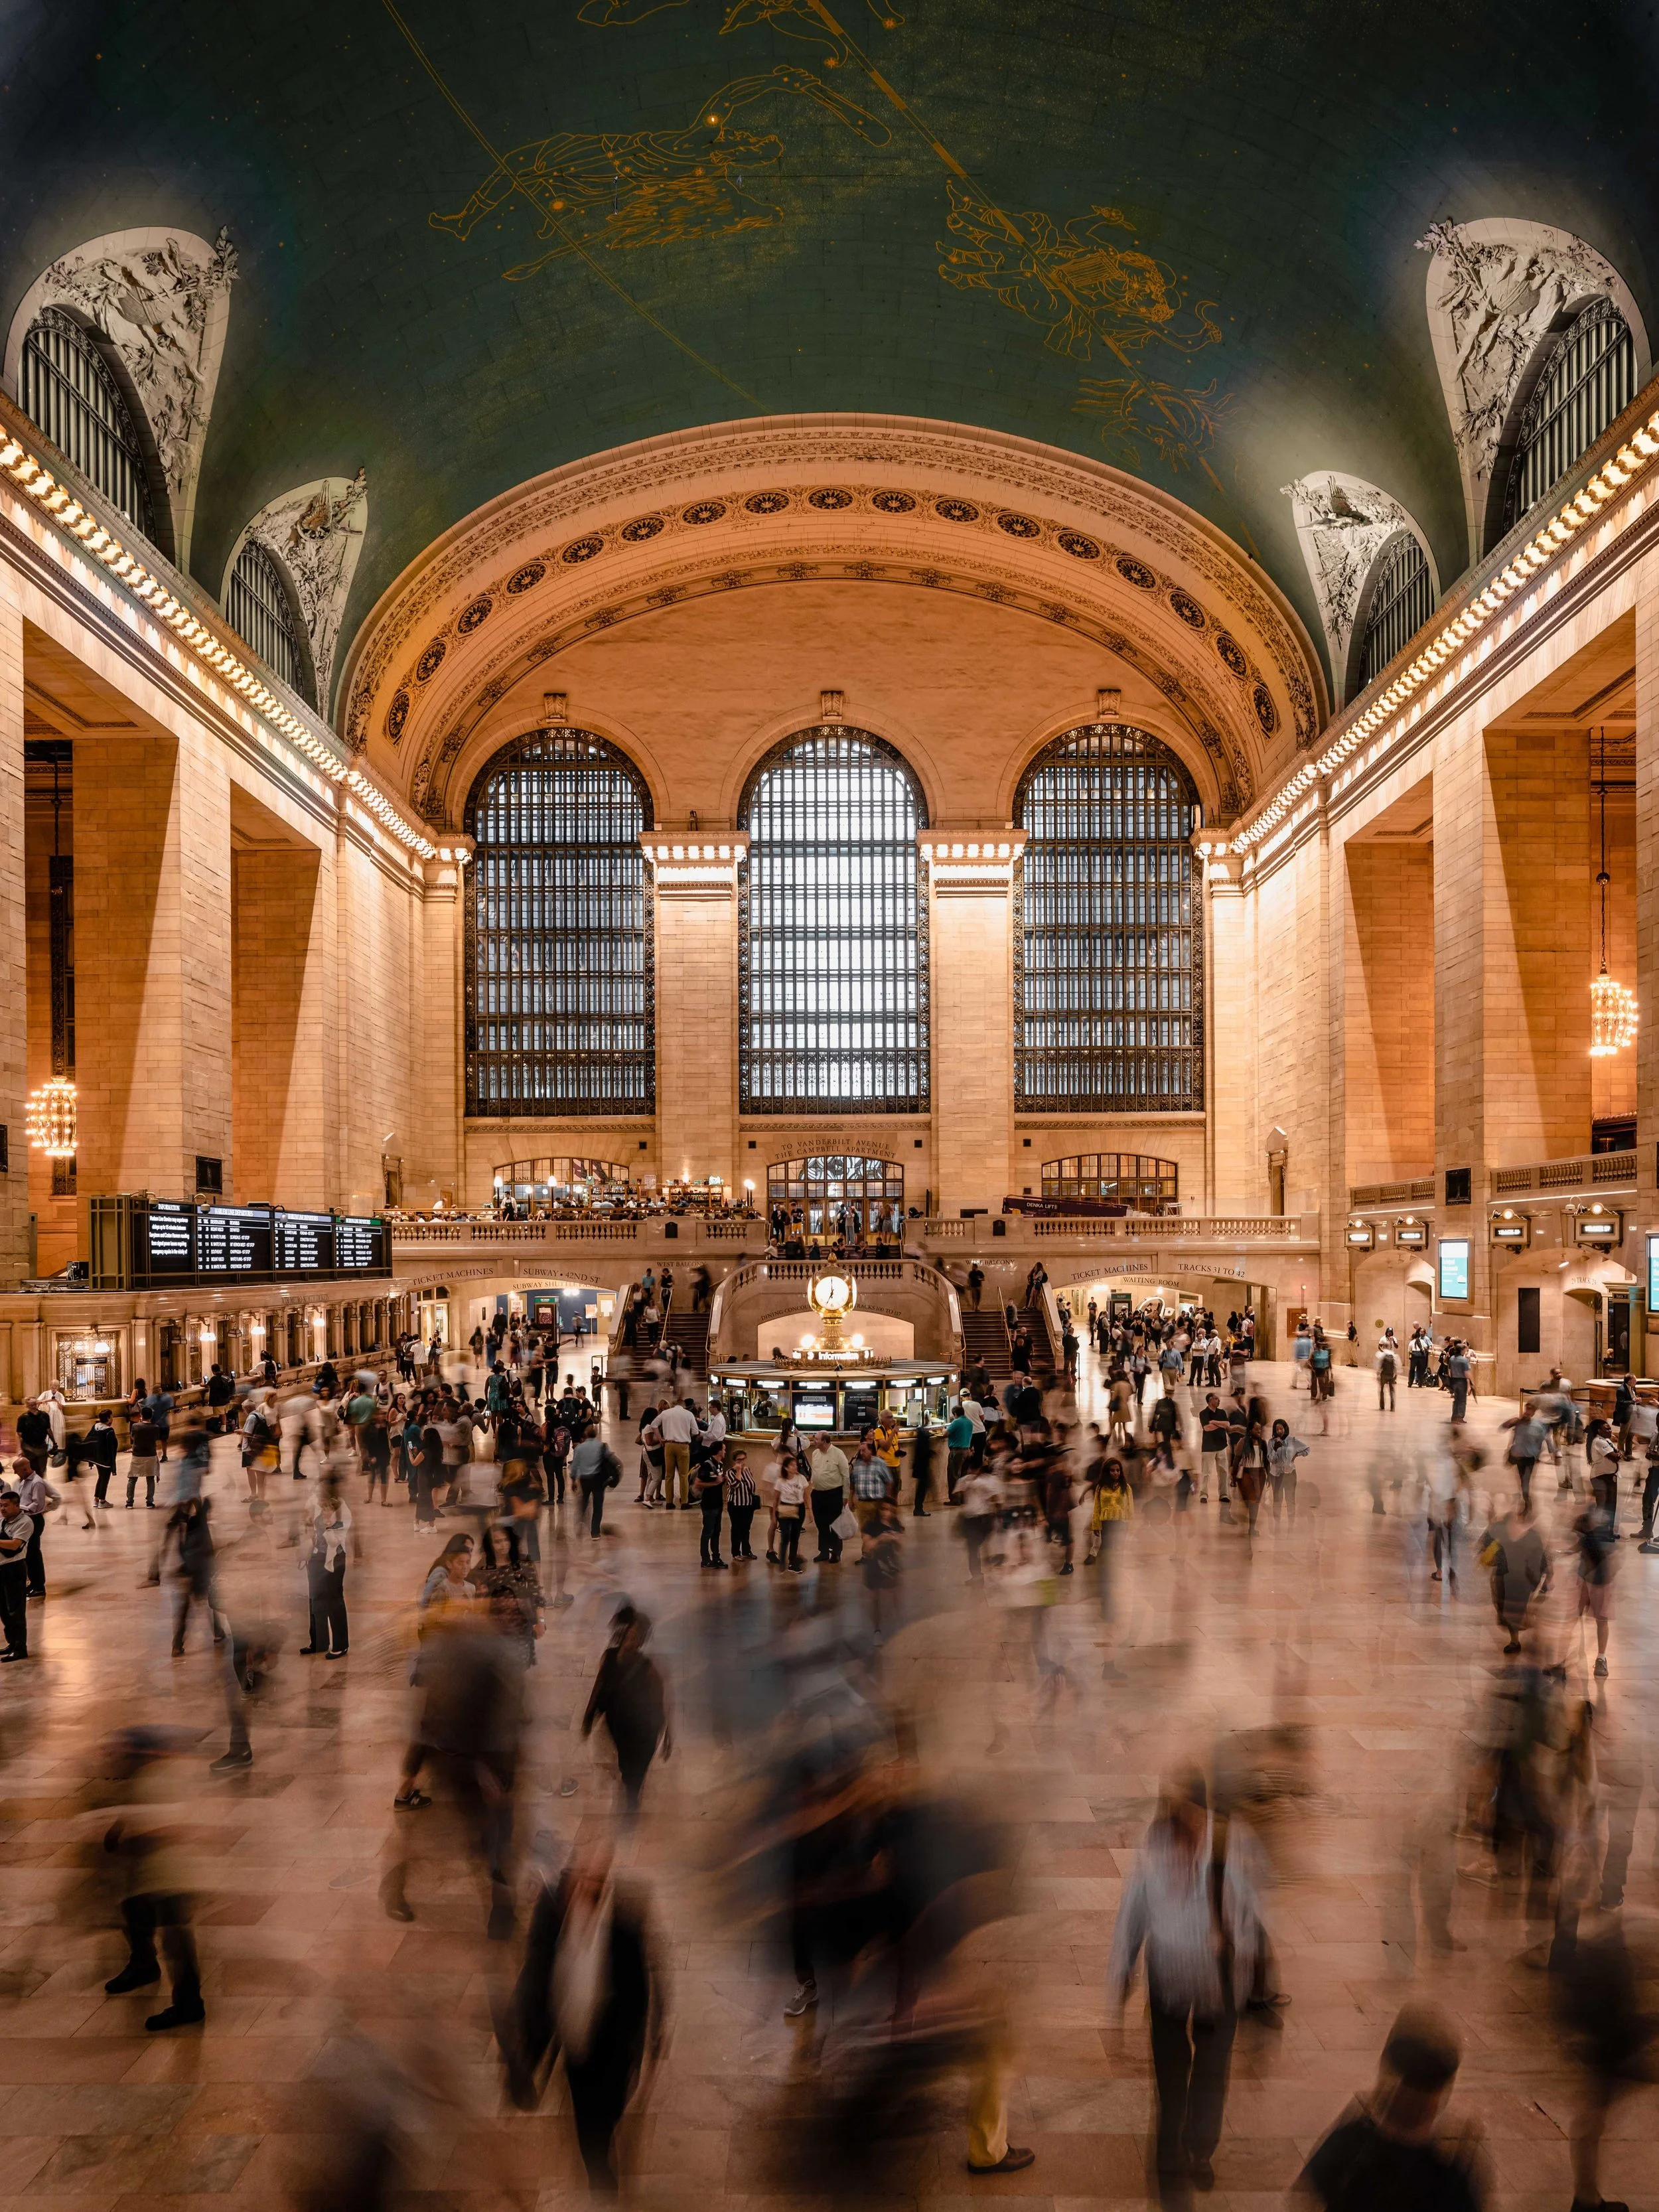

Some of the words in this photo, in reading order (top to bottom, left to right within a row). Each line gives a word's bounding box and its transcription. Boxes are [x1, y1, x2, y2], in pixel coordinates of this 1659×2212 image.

[798, 1139, 851, 1147] VANDERBILT
[856, 1140, 890, 1150] AVENUE
[775, 1151, 793, 1159] THE
[797, 1146, 841, 1155] CAMPBELL
[845, 1146, 896, 1159] APARTMENT
[524, 1268, 559, 1277] SUBWAY
[1071, 1269, 1101, 1280] TICKET
[1104, 1264, 1148, 1274] MACHINES
[1178, 1264, 1211, 1272] TRACKS
[413, 1273, 444, 1286] TICKET
[446, 1268, 494, 1278] MACHINES
[565, 1272, 588, 1281] 42ND
[1158, 1279, 1179, 1288] ROOM
[760, 1310, 783, 1321] DINING
[784, 1305, 810, 1313] CONCOU
[819, 1351, 859, 1360] Information
